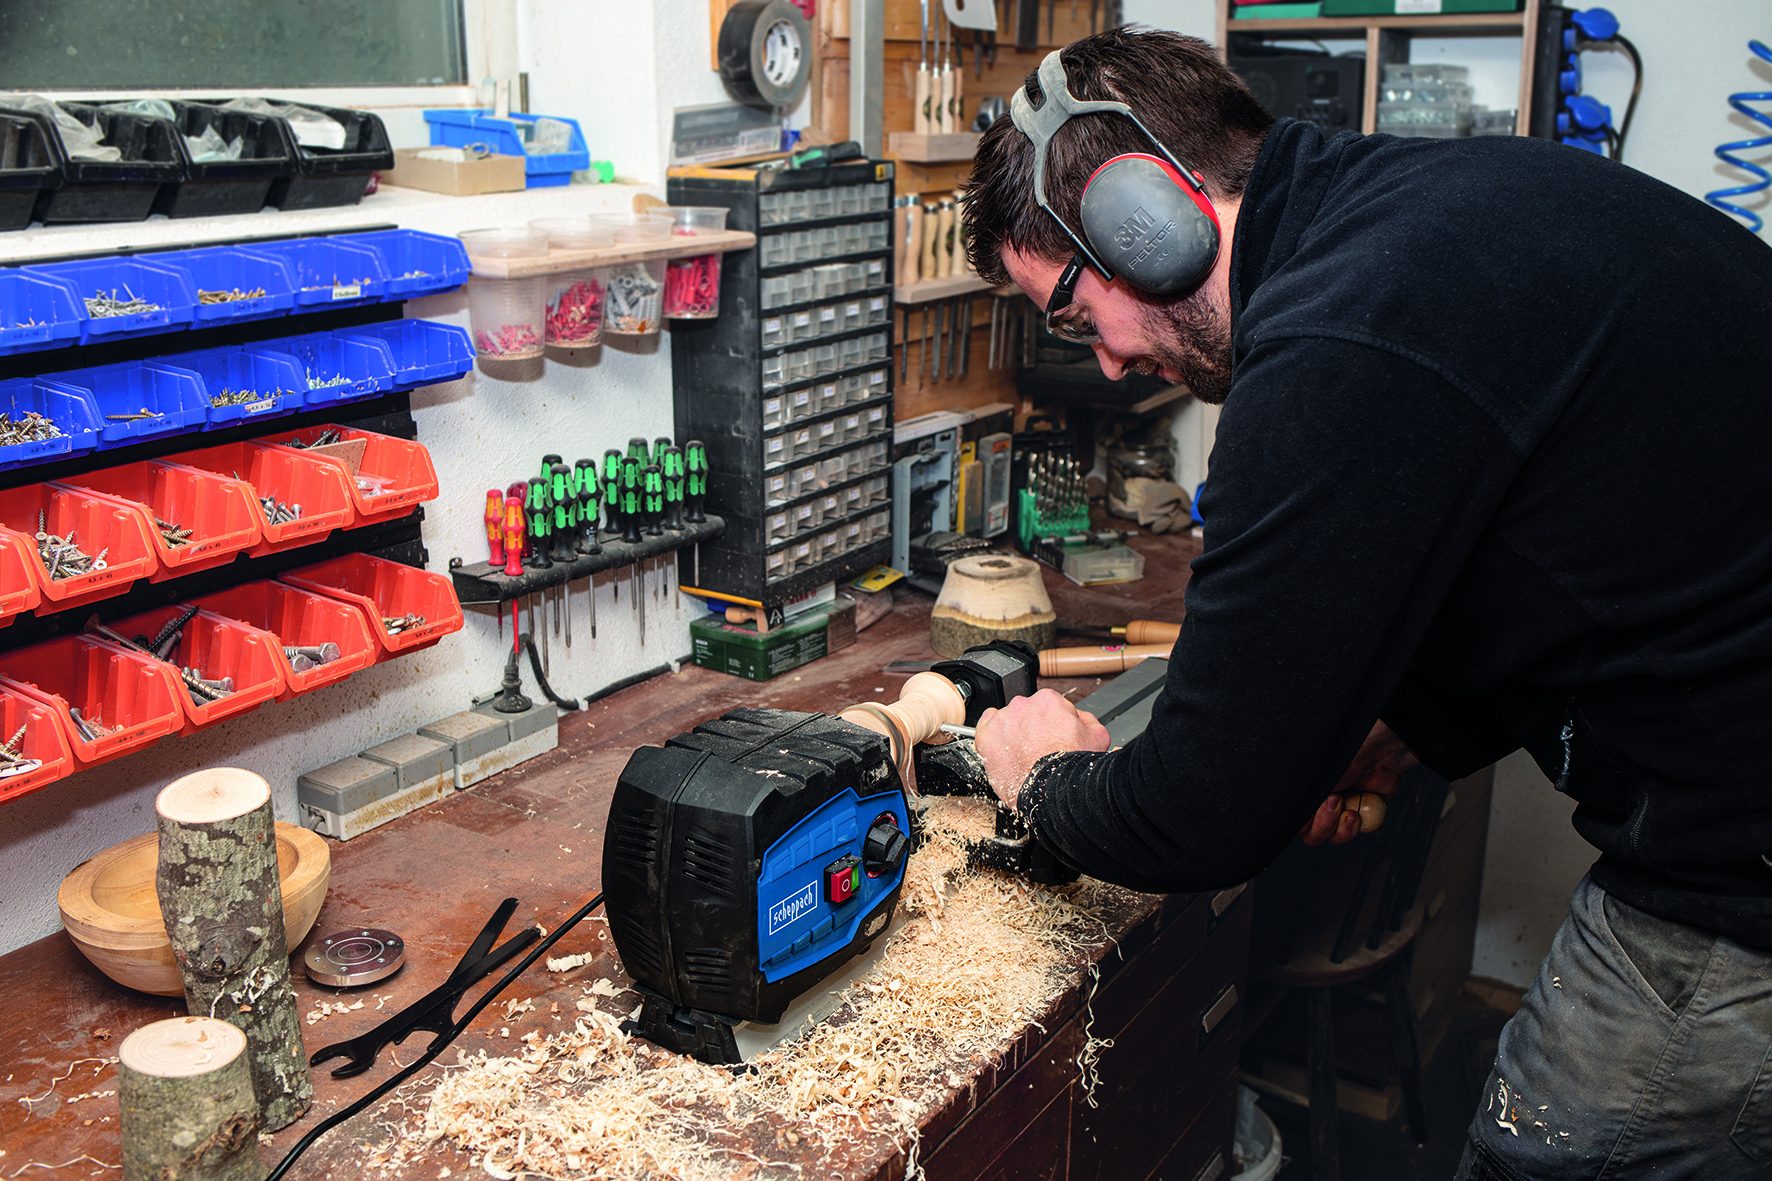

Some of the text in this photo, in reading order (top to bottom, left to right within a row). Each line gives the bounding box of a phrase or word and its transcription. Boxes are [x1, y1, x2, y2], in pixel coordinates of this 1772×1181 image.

[1114, 206, 1156, 251] 3M
[1127, 219, 1177, 270] PELTOR
[773, 885, 813, 926] scheppach
